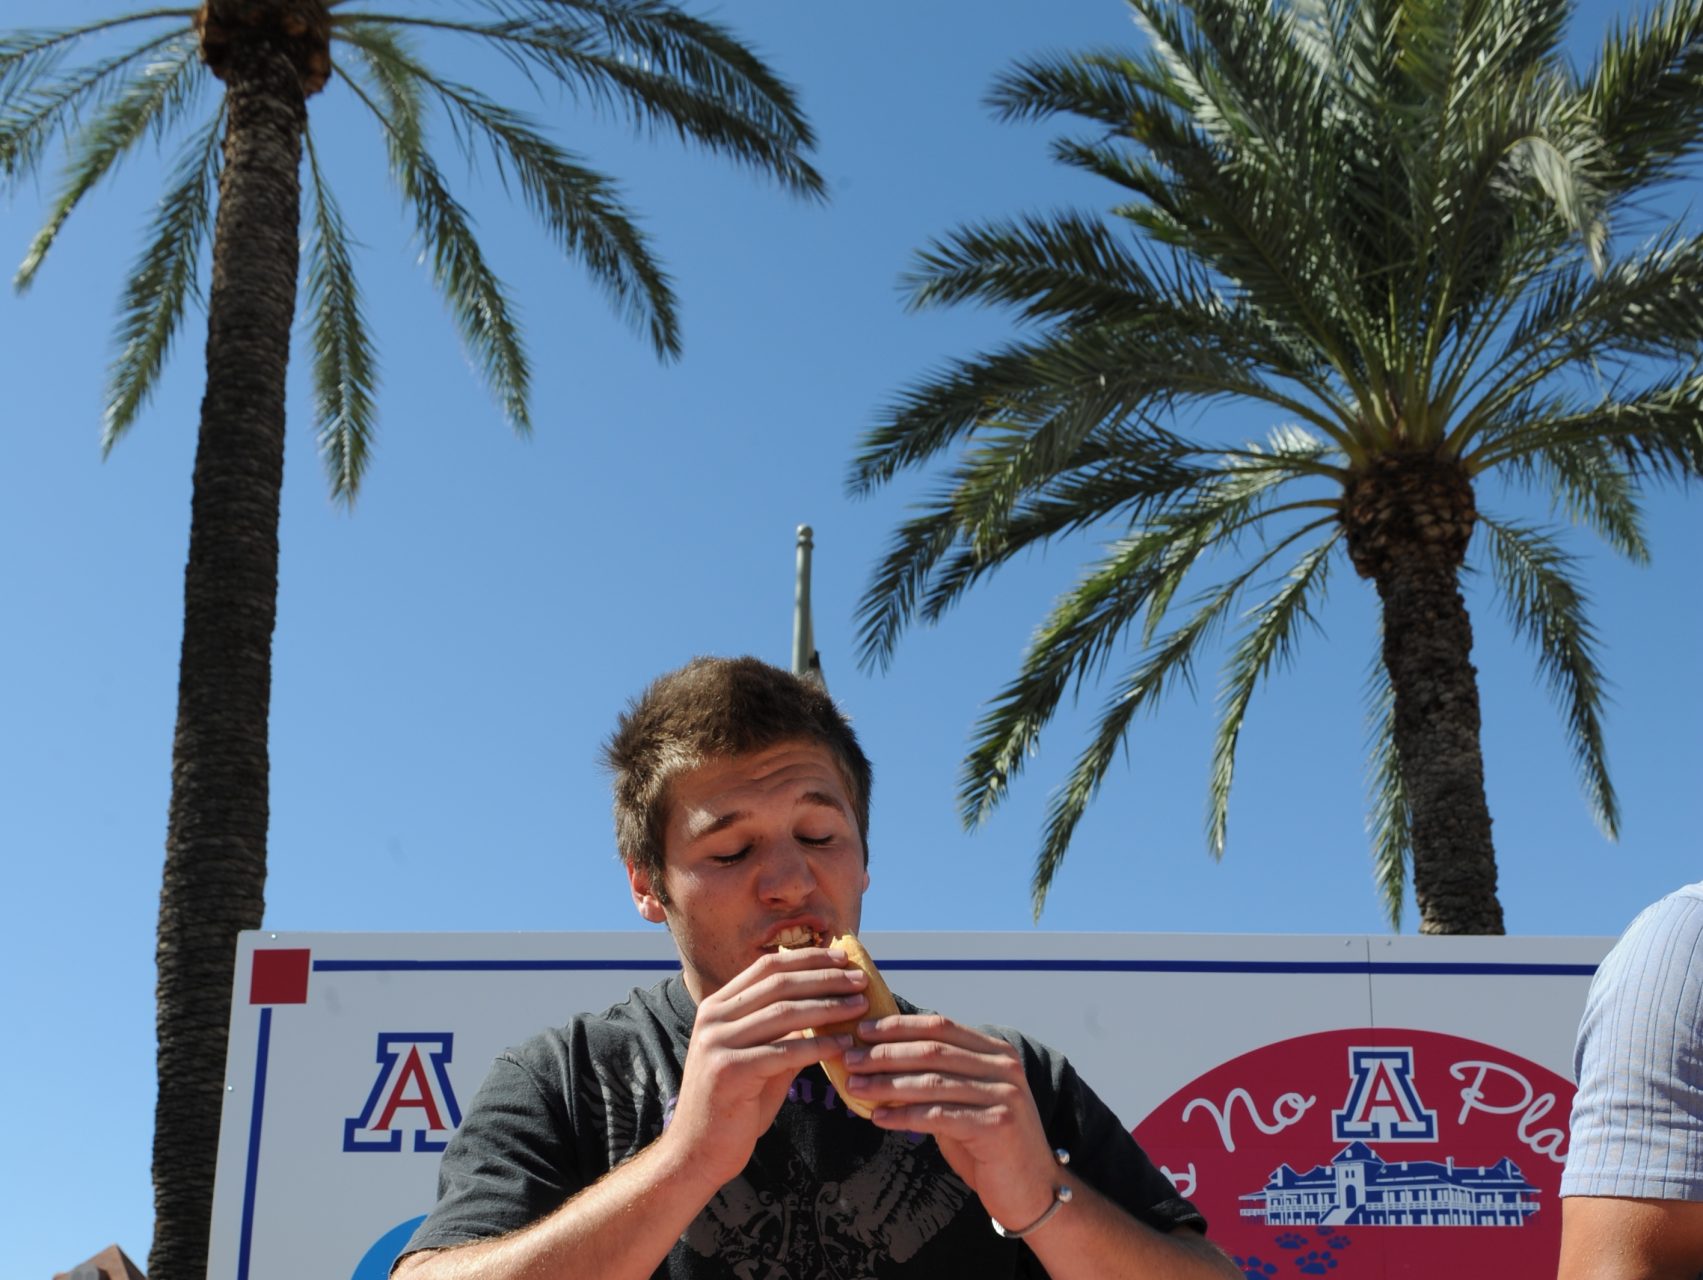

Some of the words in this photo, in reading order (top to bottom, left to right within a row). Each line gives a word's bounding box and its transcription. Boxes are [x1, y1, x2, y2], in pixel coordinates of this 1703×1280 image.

[343, 1032, 463, 1153] A
[1181, 1087, 1317, 1153] No
[1449, 1060, 1570, 1164] Pla
[1331, 1046, 1439, 1143] A
